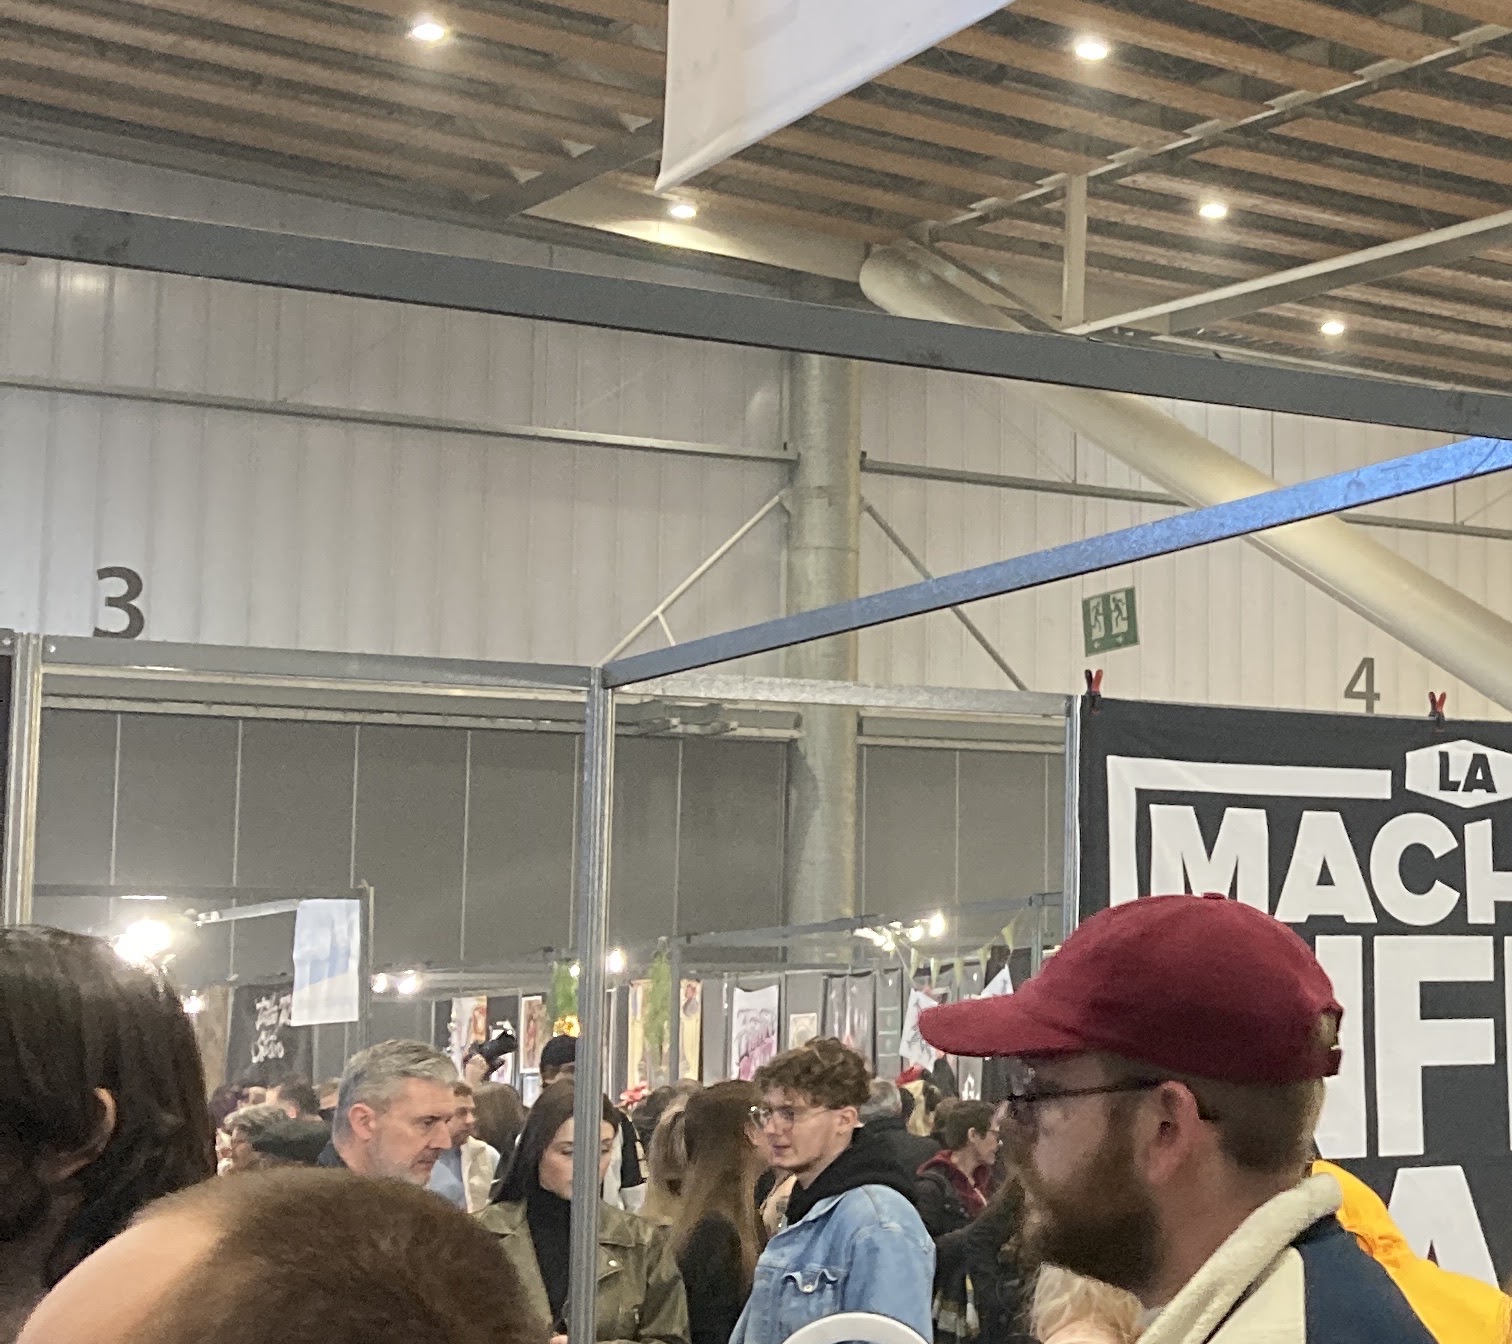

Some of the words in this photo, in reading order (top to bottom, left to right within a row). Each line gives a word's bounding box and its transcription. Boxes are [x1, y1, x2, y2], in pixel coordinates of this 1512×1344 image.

[93, 566, 145, 639] 3
[1344, 657, 1380, 712] 4
[1438, 751, 1497, 794] LA
